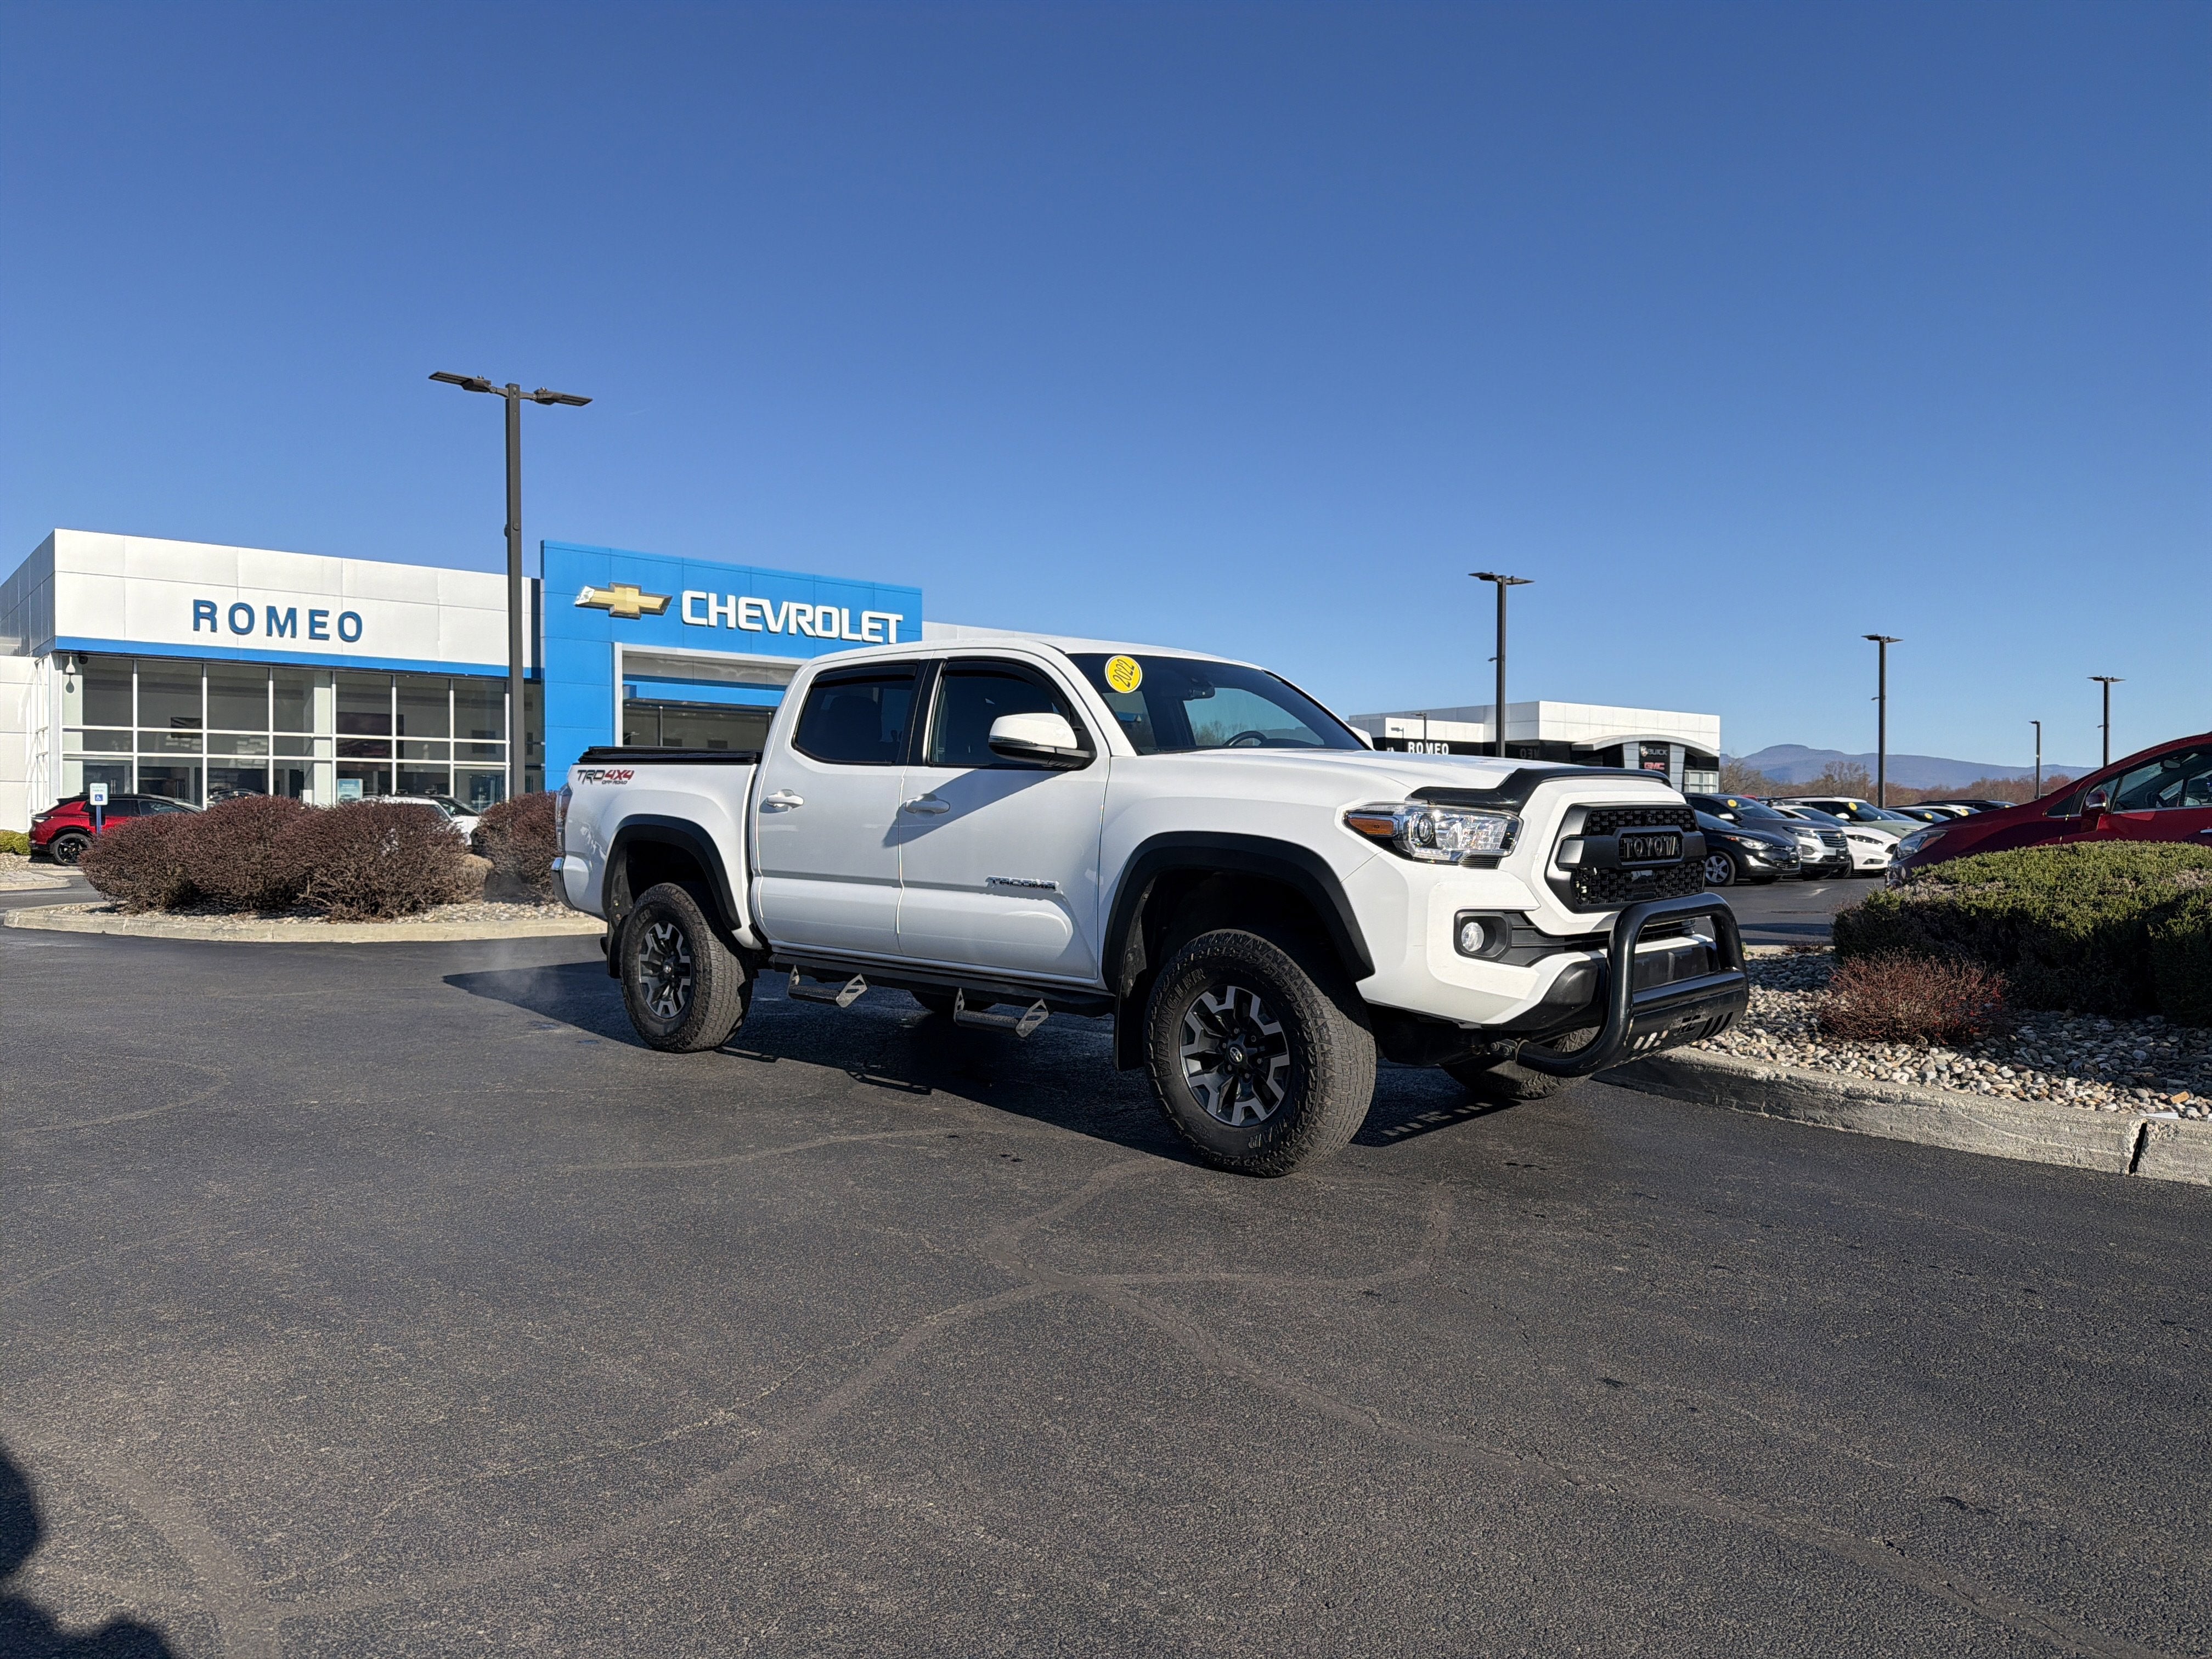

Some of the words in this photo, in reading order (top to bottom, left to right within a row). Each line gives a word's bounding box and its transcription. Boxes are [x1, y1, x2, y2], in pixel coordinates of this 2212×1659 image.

[193, 599, 363, 643] ROMEO
[682, 590, 904, 644] CHEVROLET
[1113, 659, 1135, 688] 2022
[1408, 741, 1449, 755] ROMEO
[1644, 761, 1665, 770] GMC
[1622, 836, 1680, 859] TOYOTA
[986, 876, 1057, 890] TACOMA
[1155, 968, 1206, 1077] WRANGLER
